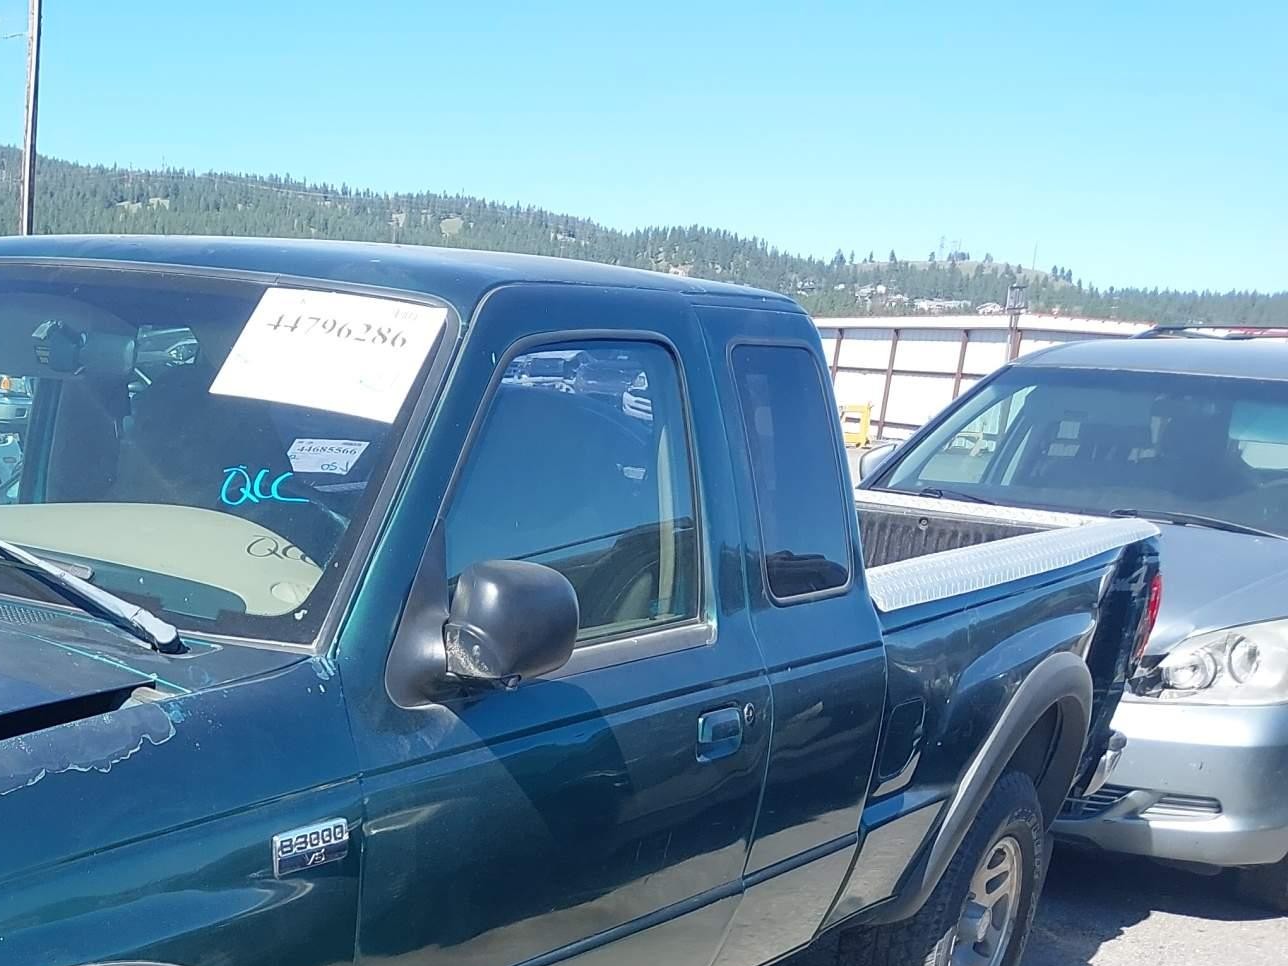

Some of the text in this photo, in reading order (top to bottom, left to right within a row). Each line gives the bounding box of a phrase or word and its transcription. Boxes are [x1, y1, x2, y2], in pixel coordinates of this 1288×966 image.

[267, 312, 409, 349] 44796286
[220, 464, 311, 506] QCC
[279, 824, 347, 856] B3000
